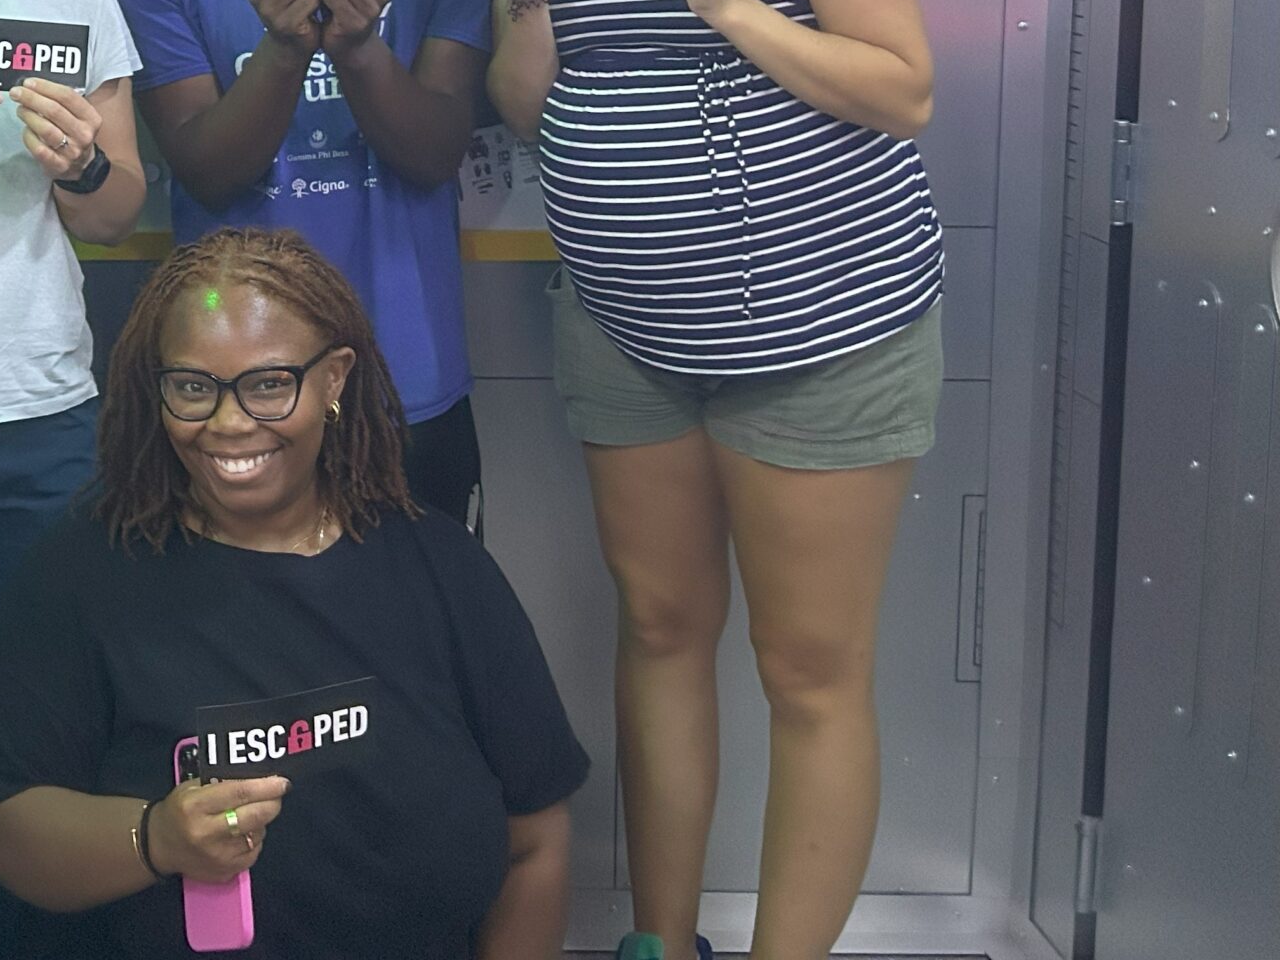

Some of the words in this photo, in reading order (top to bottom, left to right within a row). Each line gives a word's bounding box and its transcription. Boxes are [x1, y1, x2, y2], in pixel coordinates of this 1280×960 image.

[309, 180, 345, 195] Cigna
[207, 733, 217, 765] I
[228, 705, 368, 764] ESCAPED
